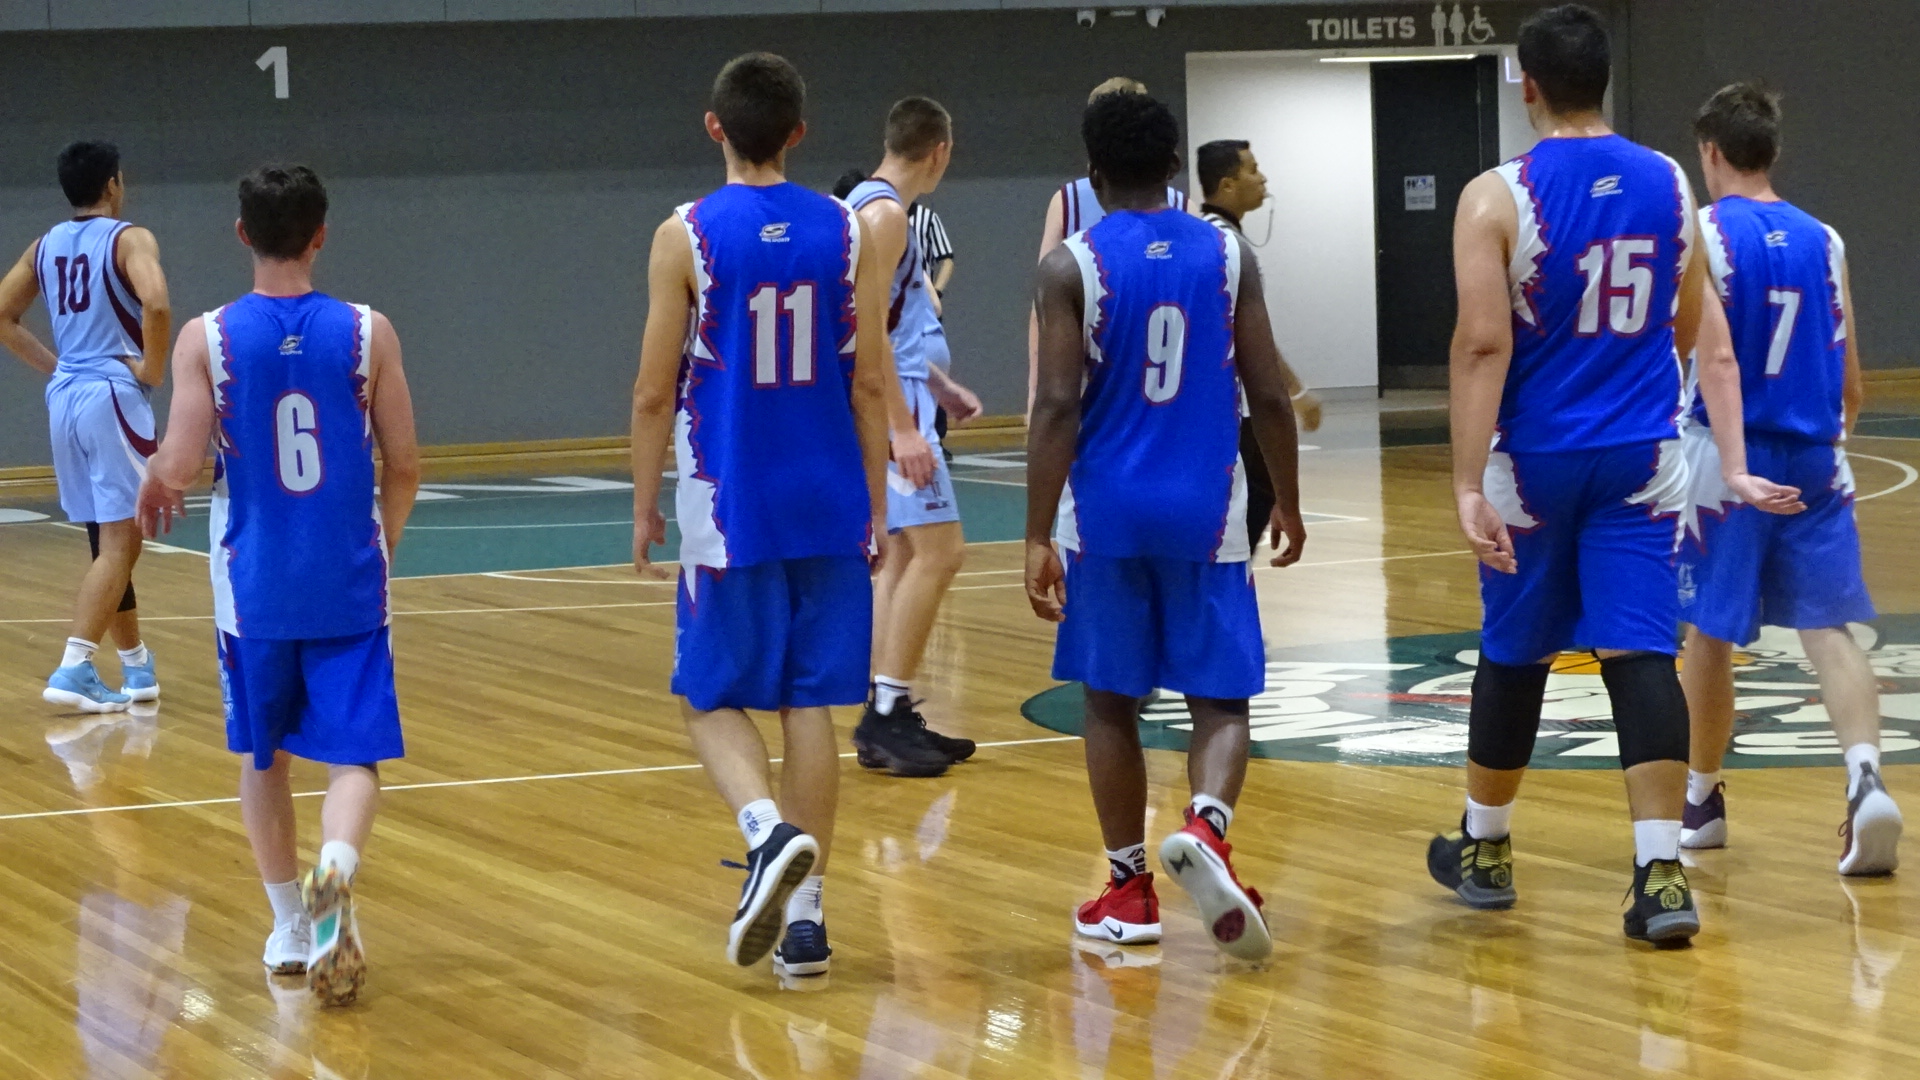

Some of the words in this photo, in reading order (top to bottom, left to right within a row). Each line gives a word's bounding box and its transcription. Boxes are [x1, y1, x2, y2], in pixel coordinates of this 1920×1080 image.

[255, 46, 289, 99] 1
[1307, 16, 1416, 41] TOILETS
[55, 253, 91, 315] 10
[1576, 237, 1656, 335] 15
[748, 283, 815, 387] 11
[1144, 303, 1187, 405] 9
[1765, 288, 1801, 376] 7
[275, 391, 323, 494] 6
